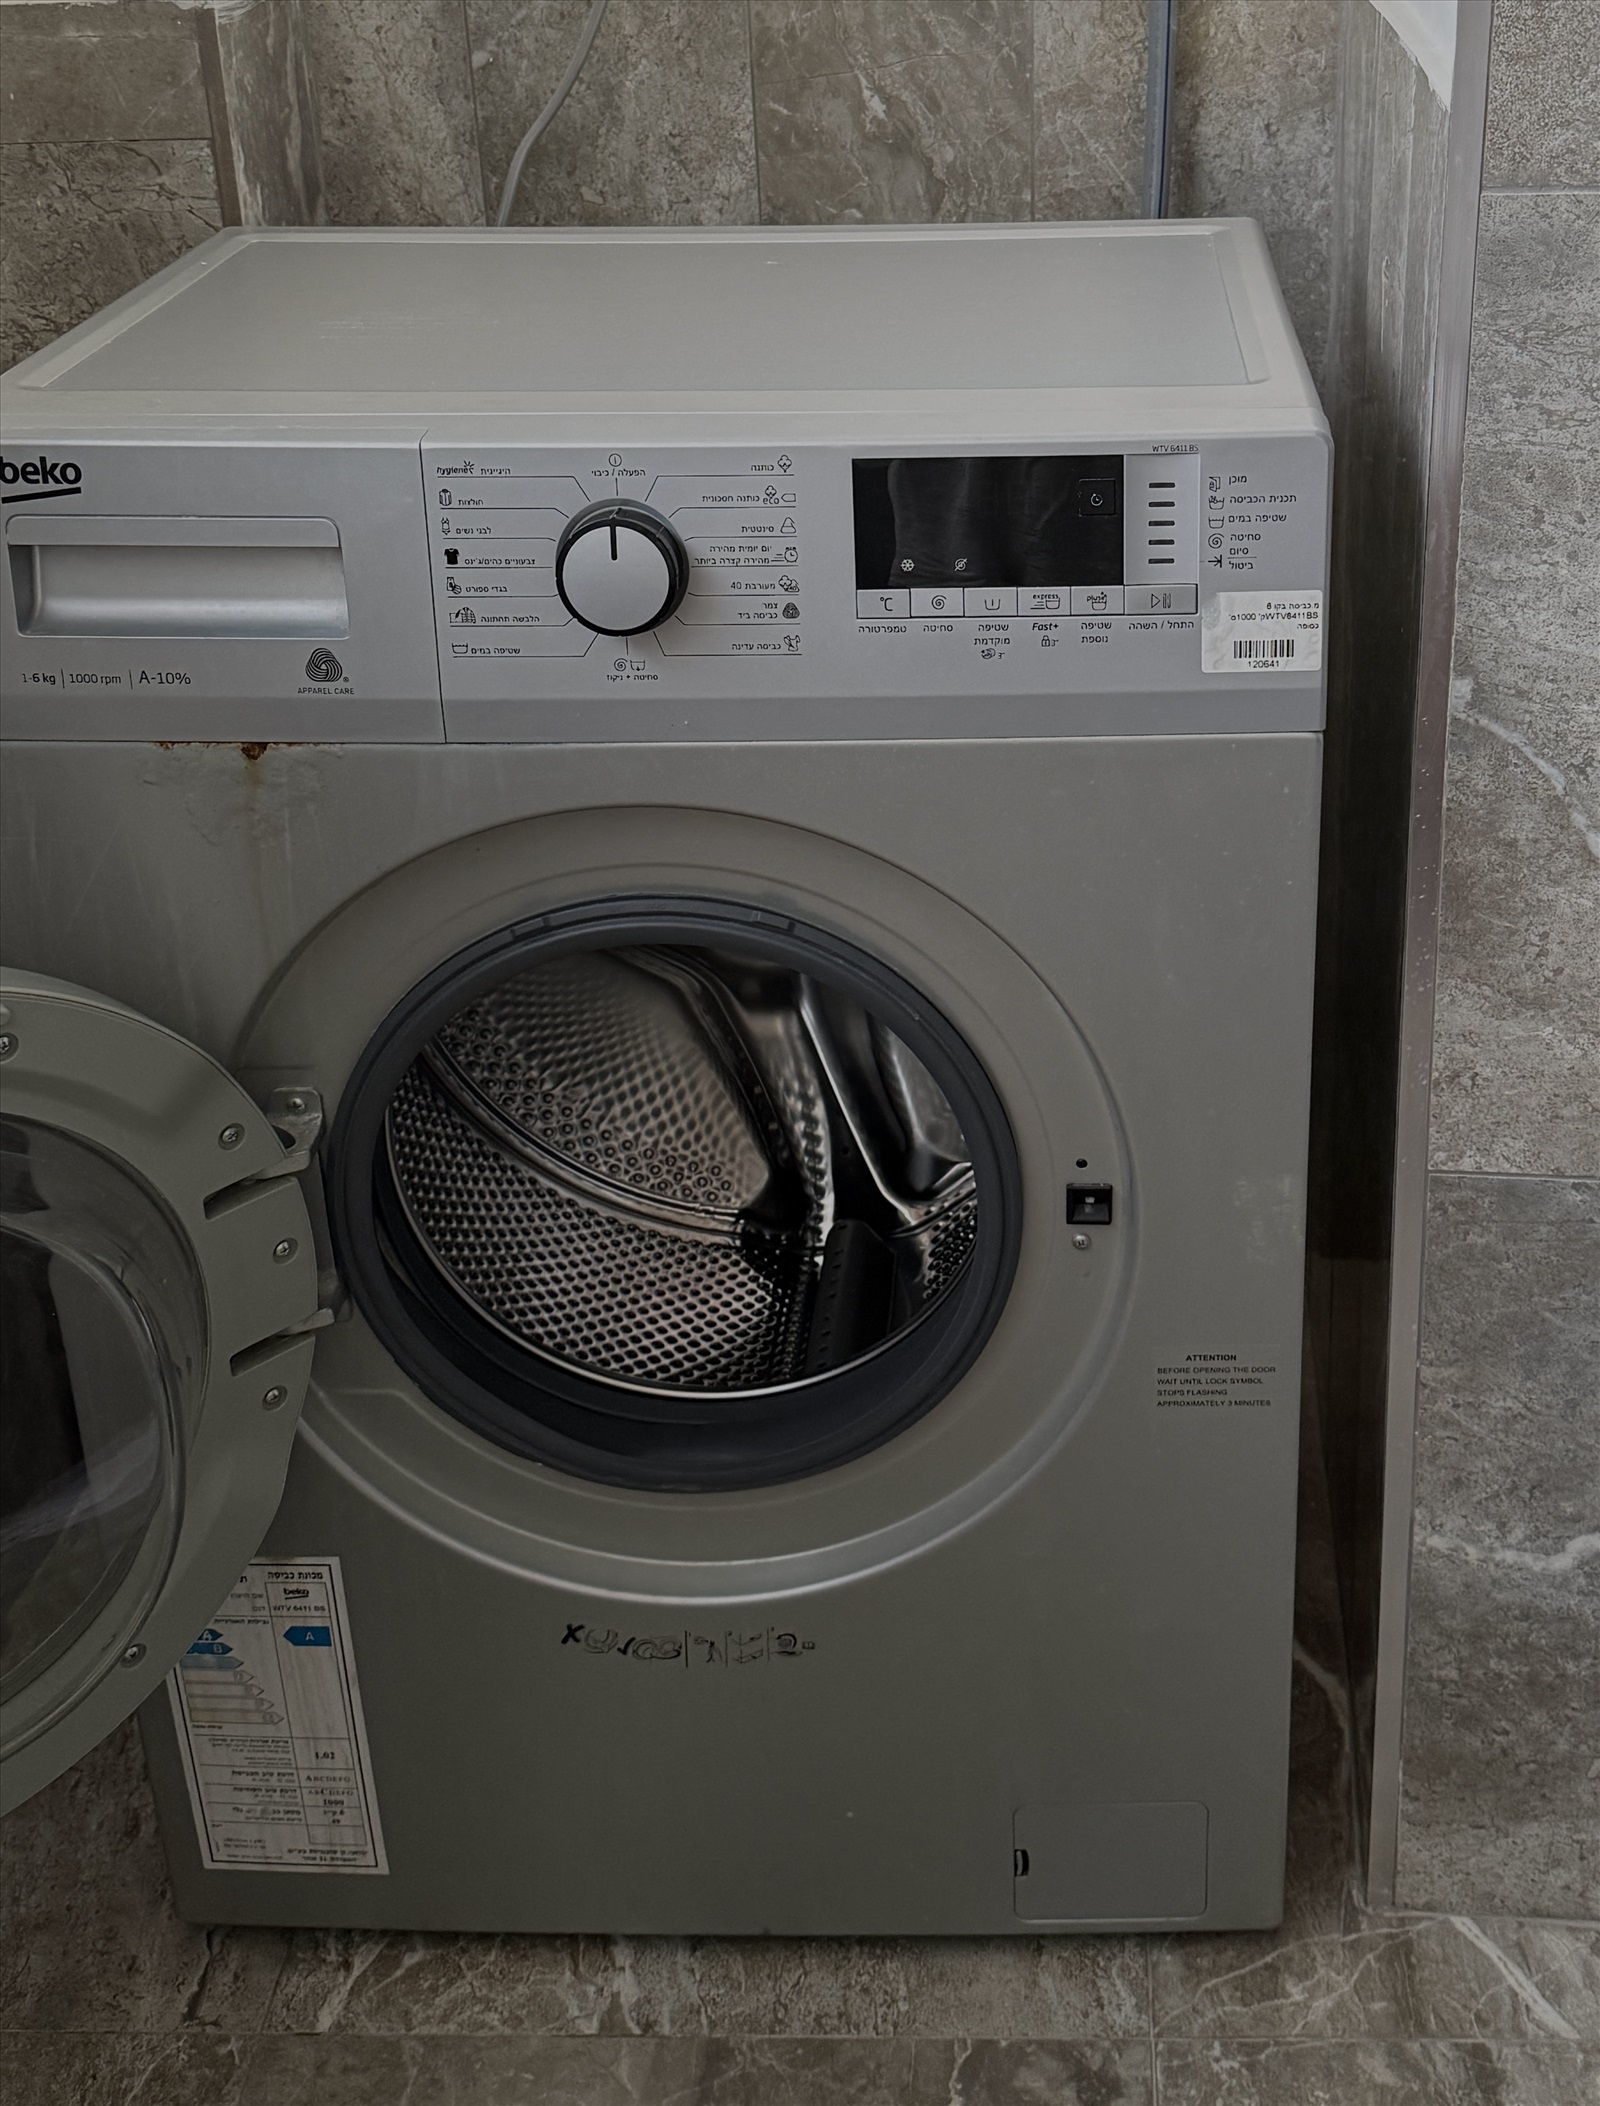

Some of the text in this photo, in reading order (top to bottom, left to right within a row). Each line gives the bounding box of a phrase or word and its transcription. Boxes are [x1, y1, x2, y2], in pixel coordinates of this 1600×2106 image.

[0, 456, 82, 485] beko
[618, 468, 646, 476] הפעלה
[1228, 475, 1247, 485] מוכן
[1269, 495, 1297, 503] תכנית
[1228, 514, 1287, 523] שטיפה במים
[1230, 533, 1261, 541] סחיטה
[1229, 547, 1249, 555] סיום
[720, 558, 741, 566] קצרה
[1229, 561, 1254, 570] ביטול
[730, 582, 742, 590] 40
[923, 624, 953, 632] סחיטה
[978, 623, 1009, 632] שטיפה
[1032, 622, 1059, 631] Fast+
[1081, 622, 1112, 630] שטיפה
[1128, 622, 1158, 630] השהה
[1167, 620, 1194, 629] התחל
[858, 625, 907, 633] טמפרטורה
[974, 637, 1011, 645] מוקדמת
[1248, 660, 1279, 668] 120641
[22, 671, 191, 685] 1-6 kg 1000 rpm A-10%
[606, 674, 623, 682] ניקוז
[268, 1571, 323, 1580] מכונת כביסה
[305, 1631, 314, 1641] A
